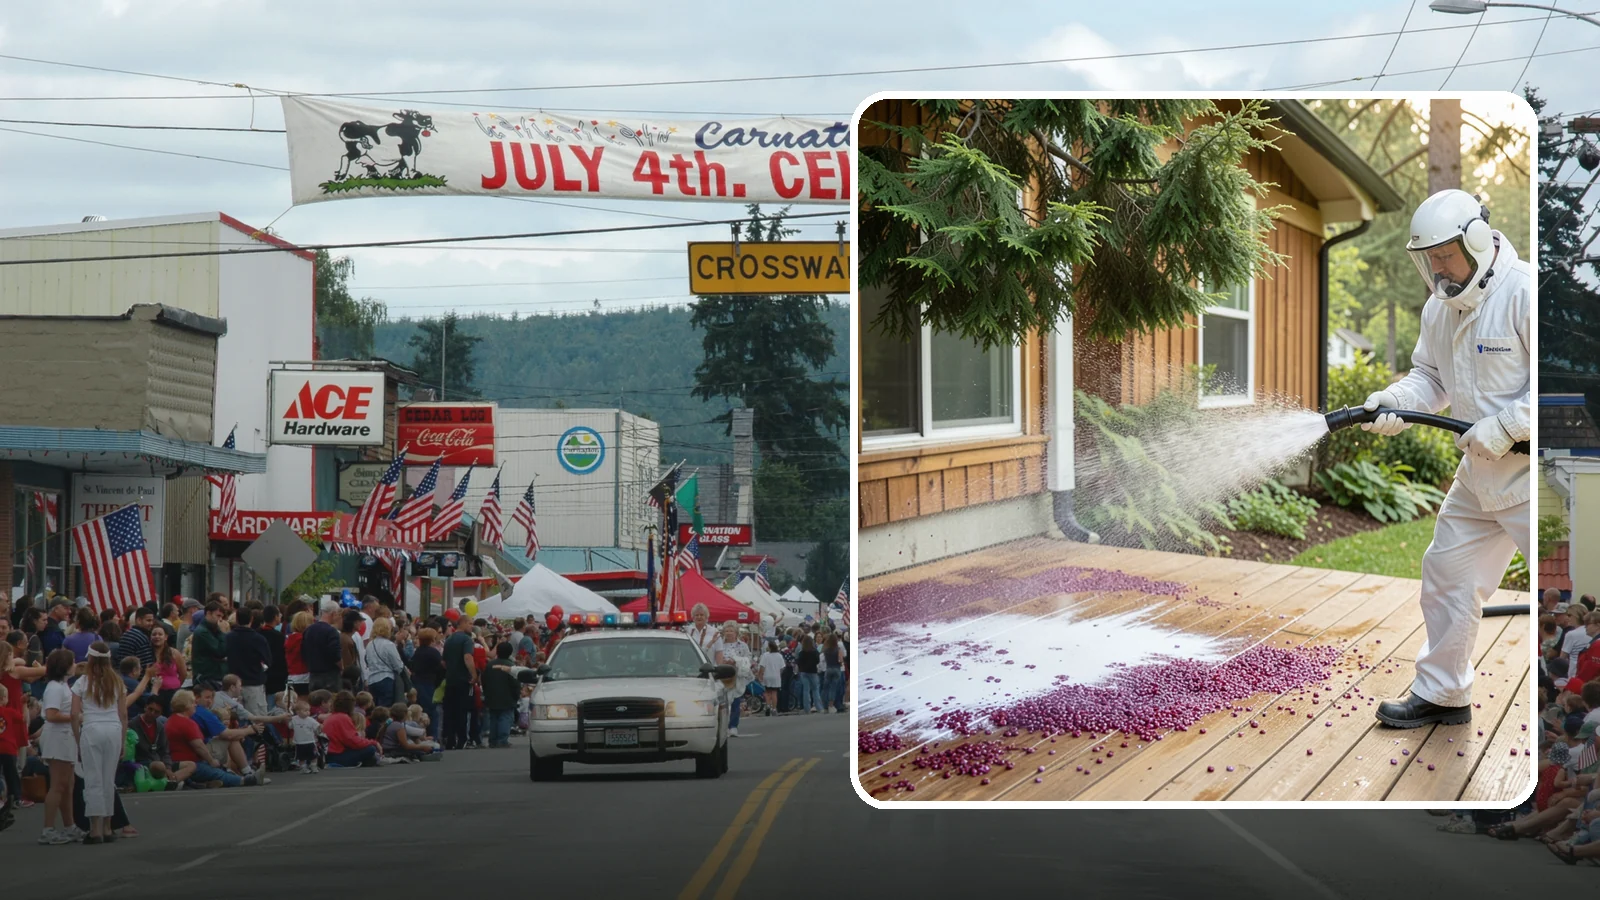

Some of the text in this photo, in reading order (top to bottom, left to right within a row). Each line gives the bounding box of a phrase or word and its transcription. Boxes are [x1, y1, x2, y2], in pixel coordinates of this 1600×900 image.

[481, 140, 605, 192] JULY
[632, 150, 746, 198] 4th.
[697, 254, 850, 280] CROSSWA
[283, 380, 373, 420] ACE
[405, 408, 453, 422] CEDAR
[283, 421, 370, 436] Hardware
[416, 428, 477, 447] Coca-Cola
[353, 467, 385, 481] Simpl
[95, 485, 124, 495] Vincent
[126, 486, 136, 495] de
[138, 486, 155, 496] Paul
[212, 515, 331, 534] HARDARE
[688, 526, 741, 535] CRNATION
[699, 535, 730, 543] GLASS
